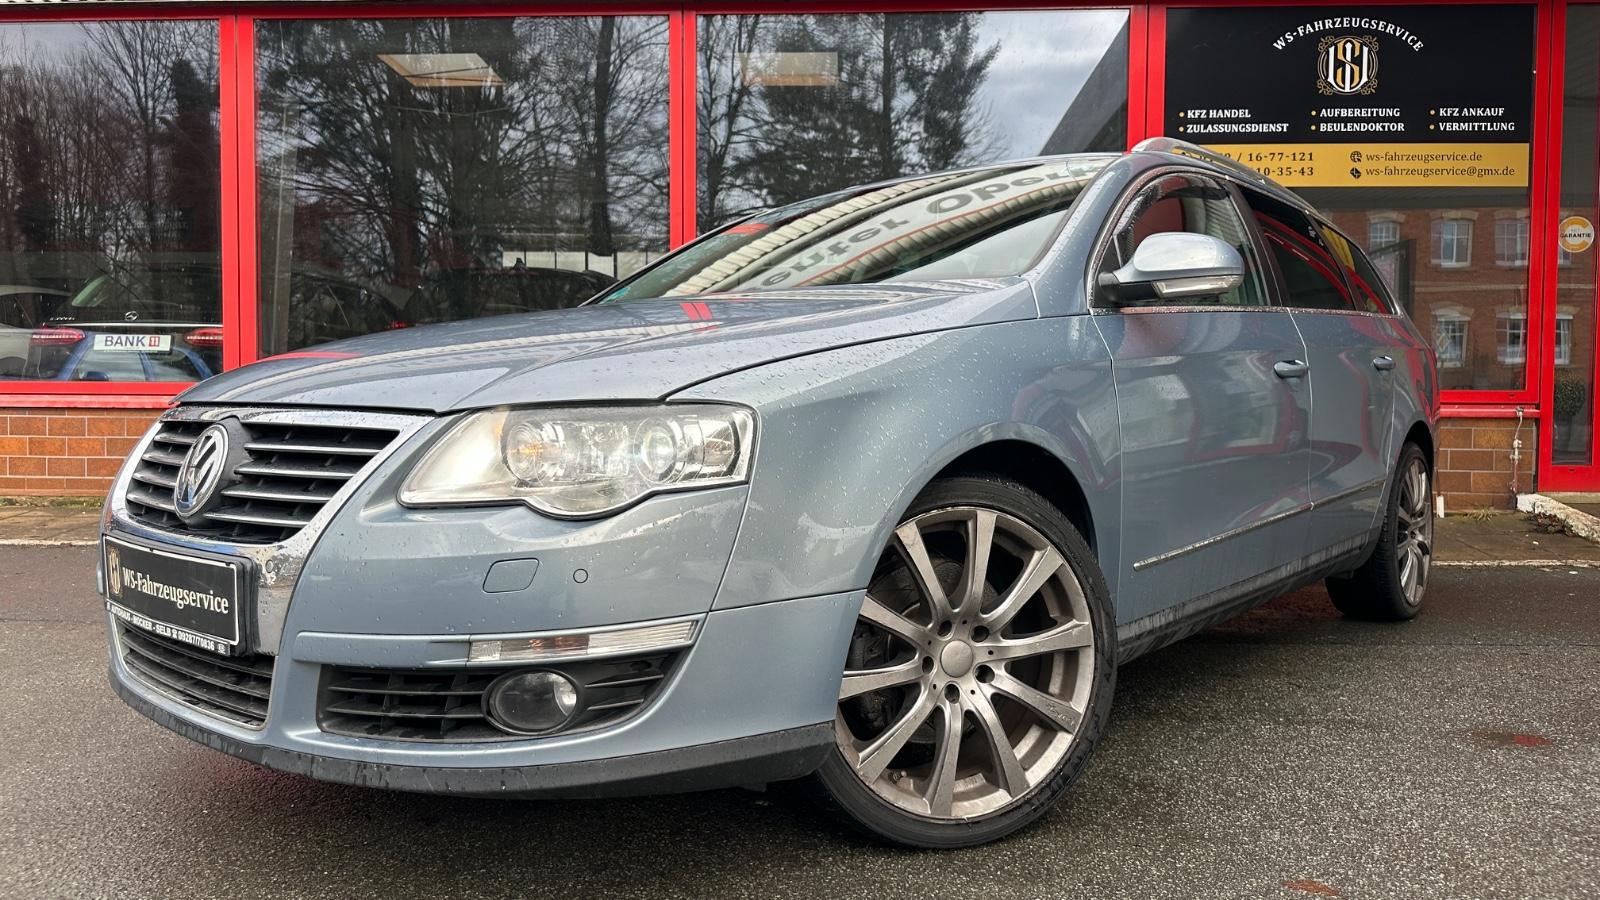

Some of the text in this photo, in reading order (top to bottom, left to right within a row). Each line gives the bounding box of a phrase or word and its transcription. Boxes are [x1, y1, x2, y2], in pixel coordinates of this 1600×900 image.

[1272, 17, 1424, 51] WS-FAHRZEUGSERVICE
[1187, 109, 1251, 119] KFZ HANDEL
[1320, 108, 1401, 118] AUFBEREITUNG
[1439, 107, 1505, 117] KFZ ANKAUF
[1186, 123, 1289, 133] ZULASSUNGSDIENST
[1320, 122, 1405, 132] BEULENDOKTOR
[1439, 122, 1515, 131] VERMITTLUNG
[1248, 151, 1314, 162] 16-77-121
[1366, 151, 1482, 163] ws-fahrzeugservice.de
[1365, 165, 1515, 178] ws-fahrzeugservice@gmx.de
[104, 335, 146, 347] BANK
[122, 567, 229, 614] WS-Fahrzeugservice
